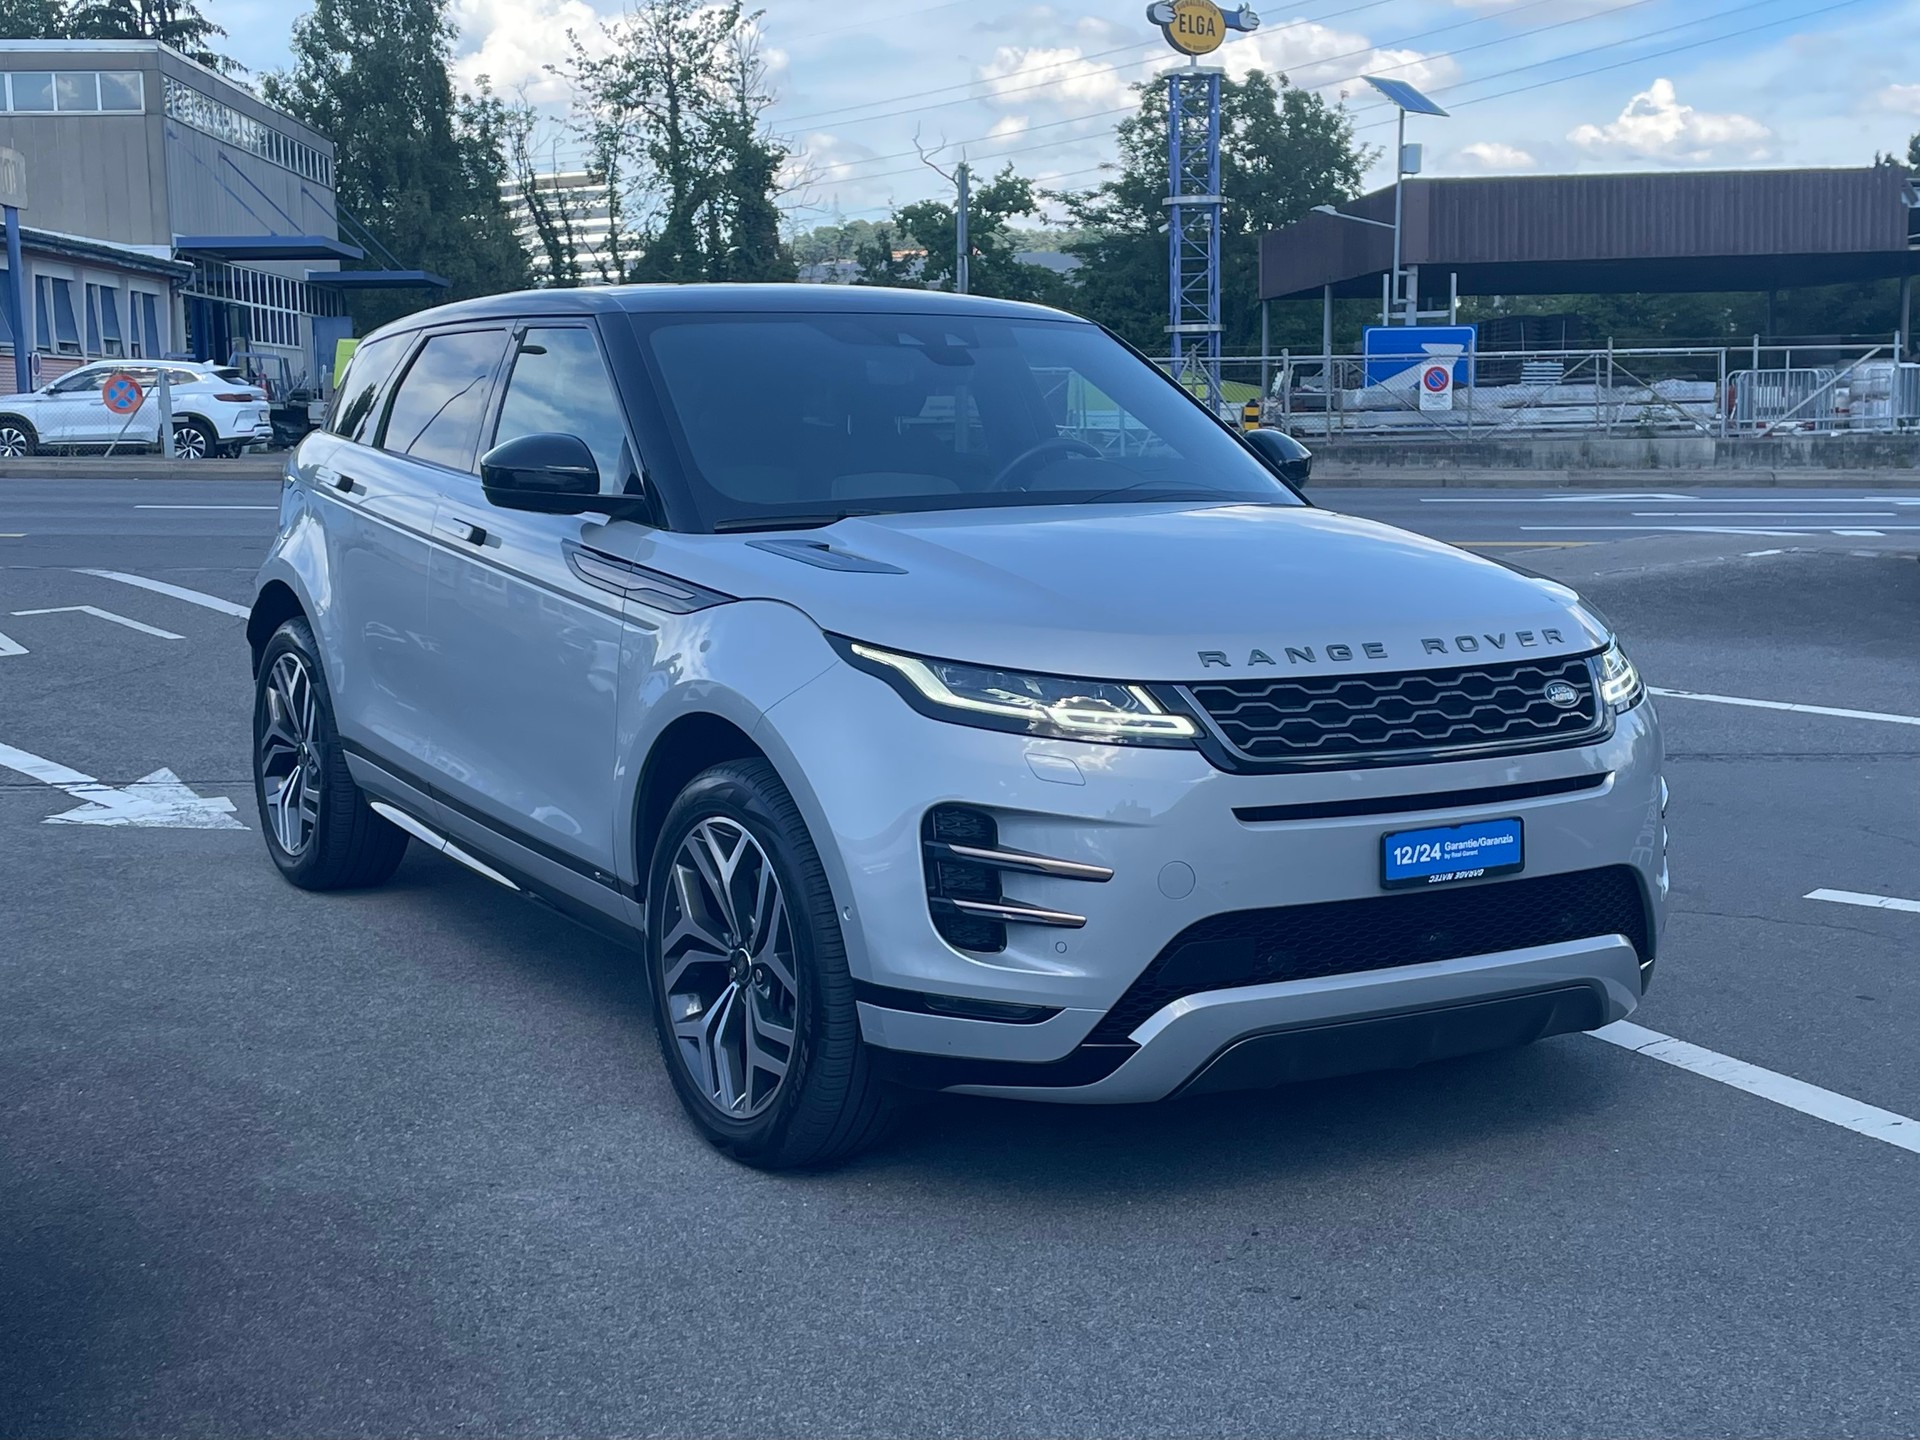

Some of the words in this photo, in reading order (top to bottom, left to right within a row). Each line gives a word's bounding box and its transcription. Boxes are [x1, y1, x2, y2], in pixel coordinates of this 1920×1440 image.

[1179, 13, 1216, 37] ELGA
[1197, 641, 1389, 668] RANGE
[1420, 627, 1566, 655] ROVER
[1444, 833, 1514, 852] Garantie/Garanzia
[1393, 842, 1442, 866] 12/24
[1428, 872, 1454, 883] NATEC
[1454, 868, 1485, 880] GARAGE
